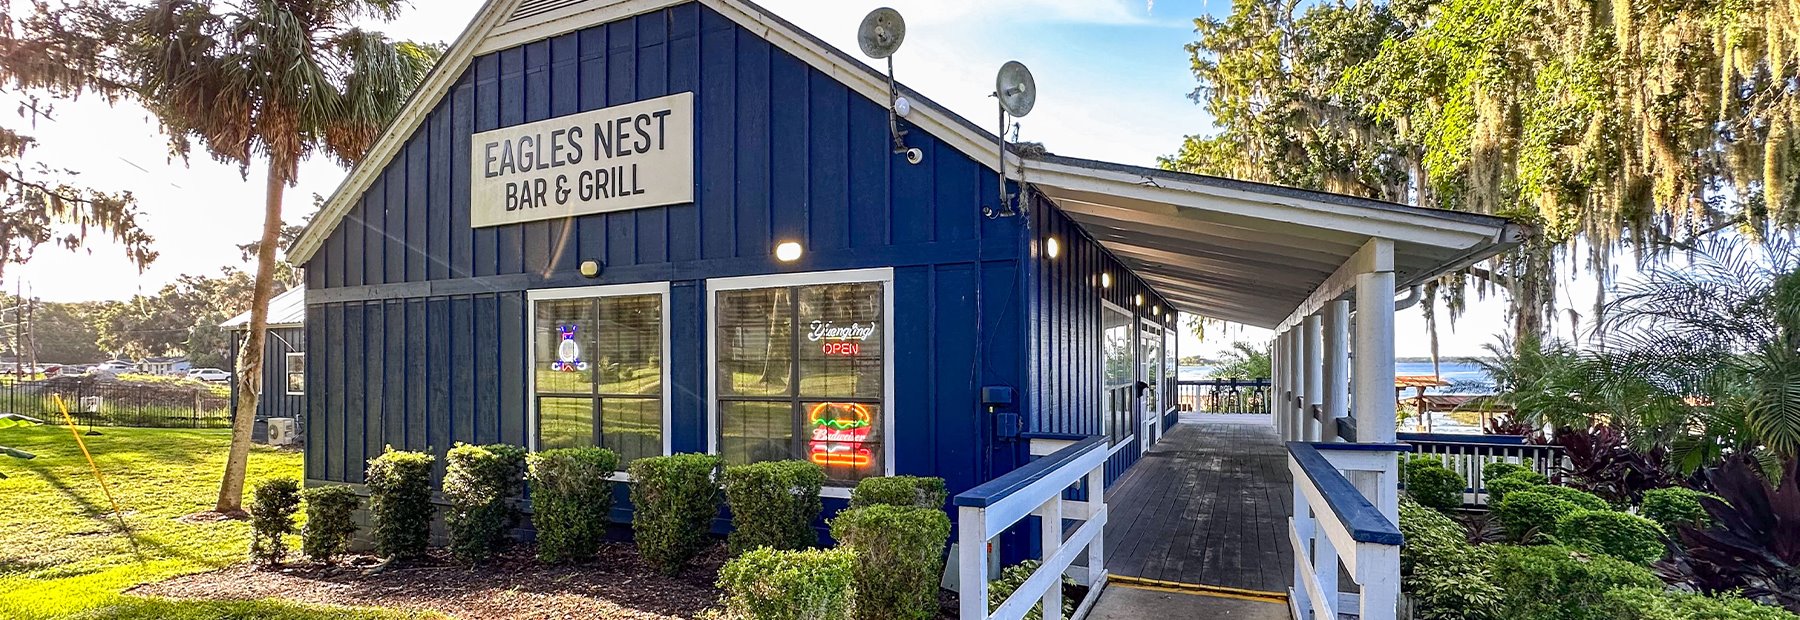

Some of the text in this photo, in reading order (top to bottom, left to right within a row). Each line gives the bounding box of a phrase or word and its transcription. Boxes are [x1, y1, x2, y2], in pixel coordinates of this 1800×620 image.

[484, 109, 672, 179] EAGLES NEST
[505, 163, 645, 212] BAR & GRILL
[808, 320, 875, 341] Yuengling
[822, 343, 859, 355] OPEN
